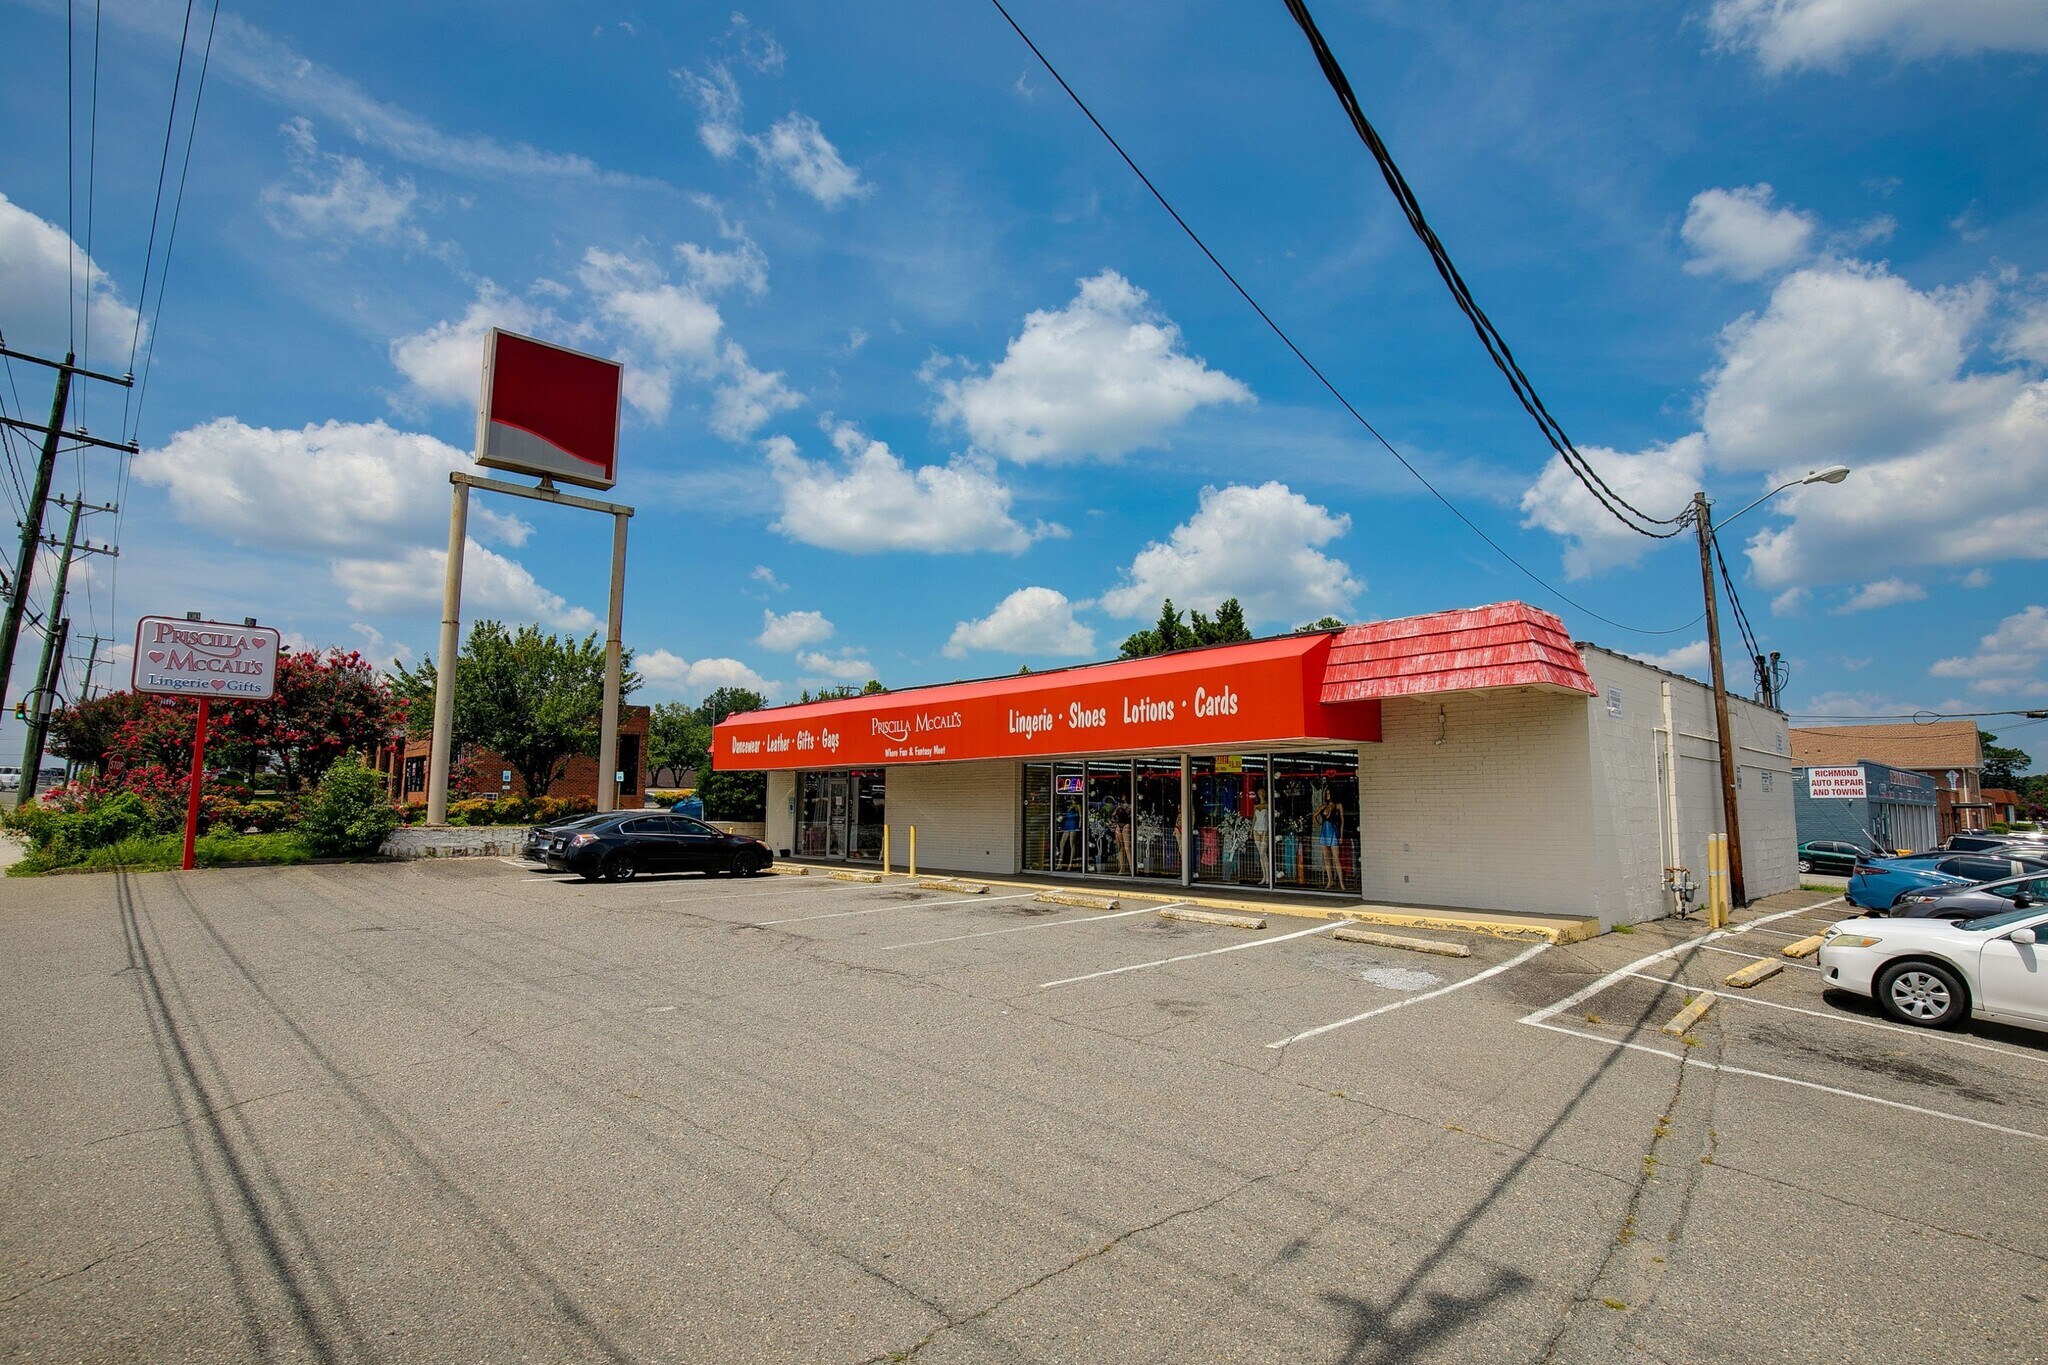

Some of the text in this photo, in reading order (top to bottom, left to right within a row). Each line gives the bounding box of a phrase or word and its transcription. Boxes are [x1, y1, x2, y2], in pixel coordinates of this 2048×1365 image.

[153, 622, 250, 658] PRISCILLA
[148, 674, 261, 692] Lingerie Gifts
[1009, 685, 1239, 740] Lingerie Shoes Lotions Cards
[871, 717, 912, 742] PRISCILLA
[731, 727, 840, 754] Dancewear Leather Gifts Gags
[908, 746, 914, 756] &
[914, 745, 932, 758] Fantasy
[109, 760, 124, 770] STOP
[1815, 769, 1859, 777] RICHMOND
[1811, 779, 1832, 787] AUTO
[1831, 788, 1864, 796] TOWING
